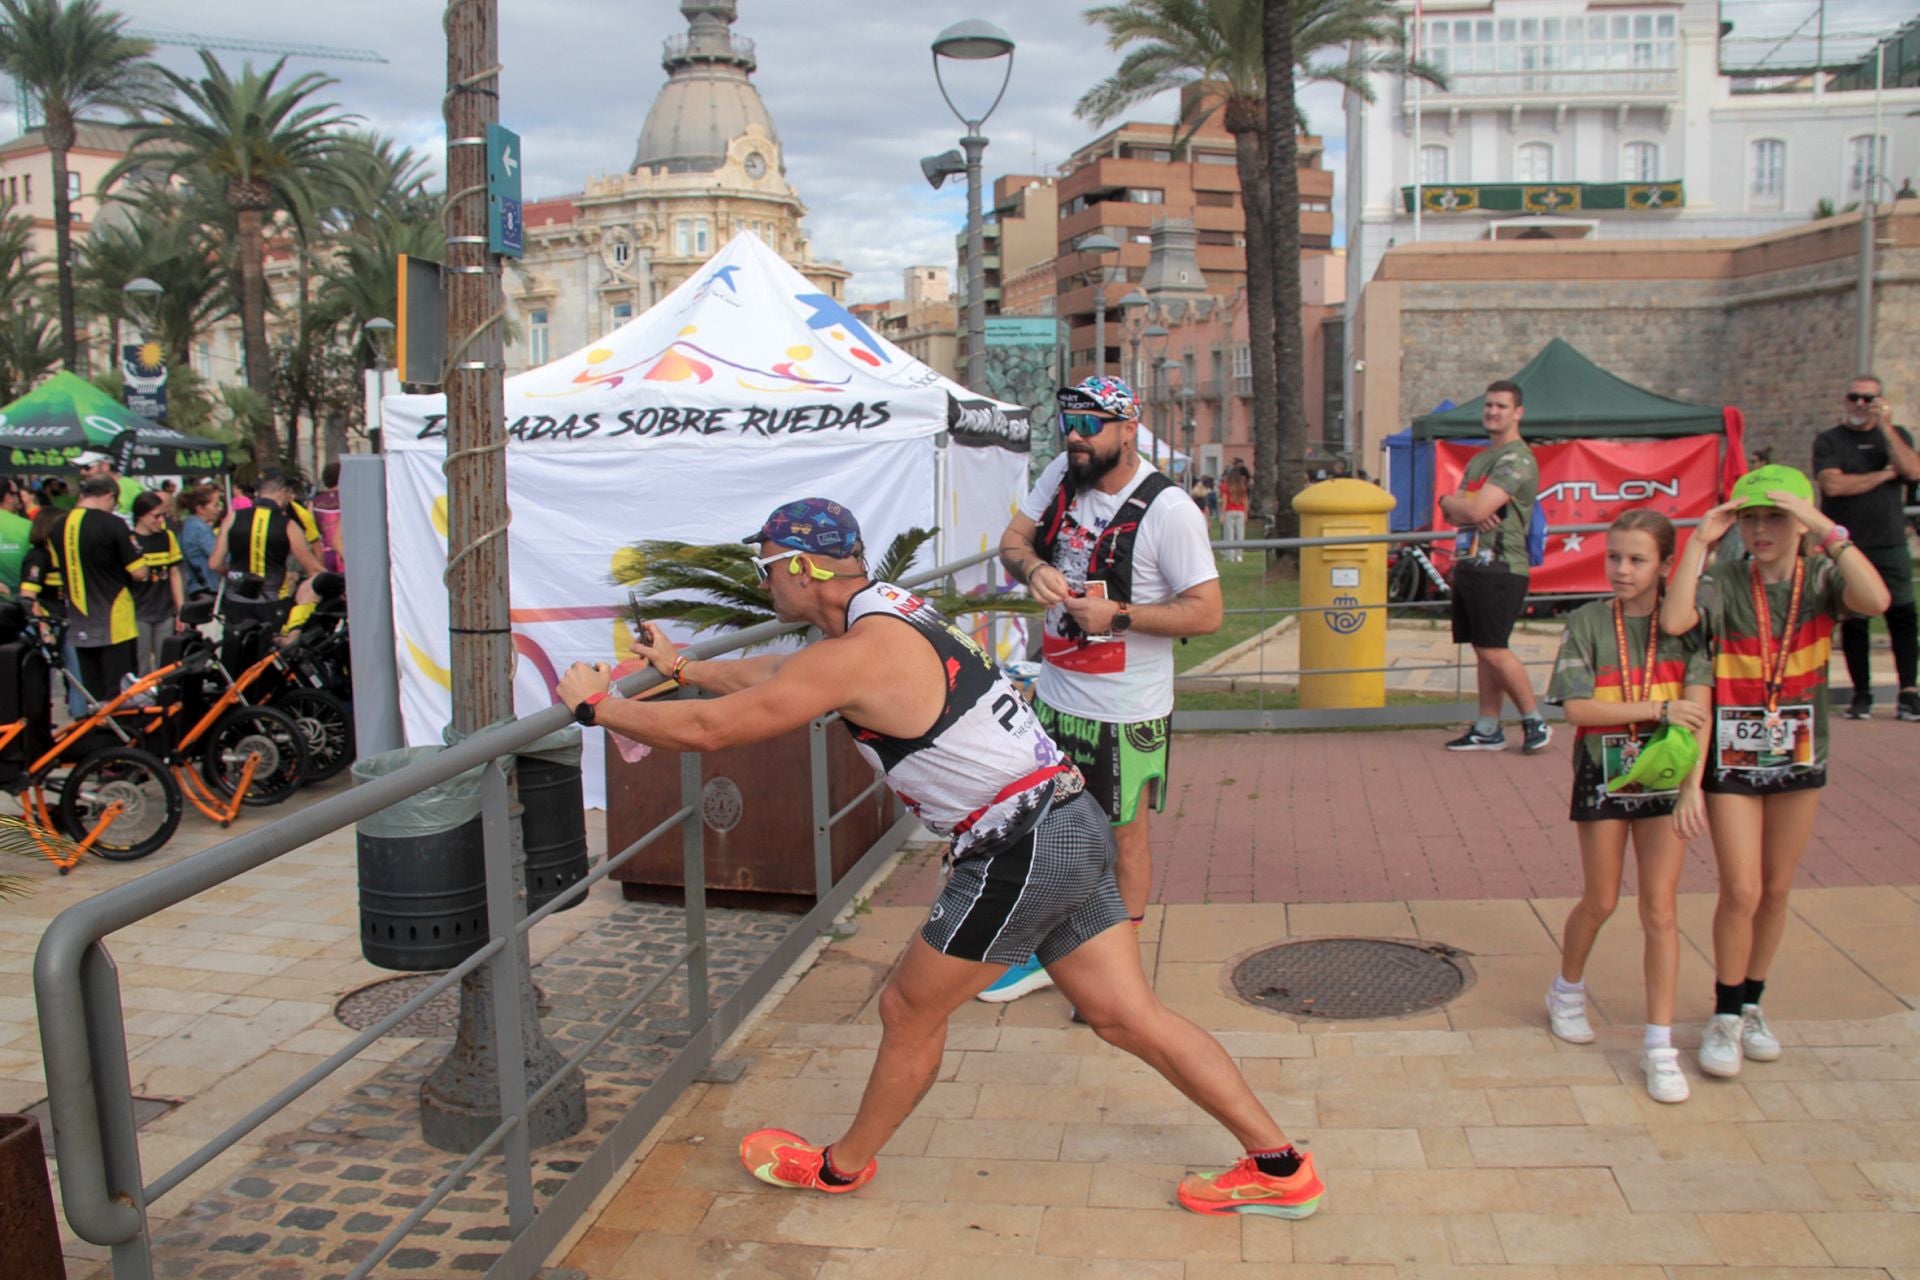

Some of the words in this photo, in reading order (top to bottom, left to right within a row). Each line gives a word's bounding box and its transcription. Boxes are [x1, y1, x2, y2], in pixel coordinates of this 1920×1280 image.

[416, 412, 600, 442] ZADAS
[609, 406, 732, 437] SOBRE
[739, 400, 891, 438] RUEDAS
[1535, 477, 1680, 502] ATLON
